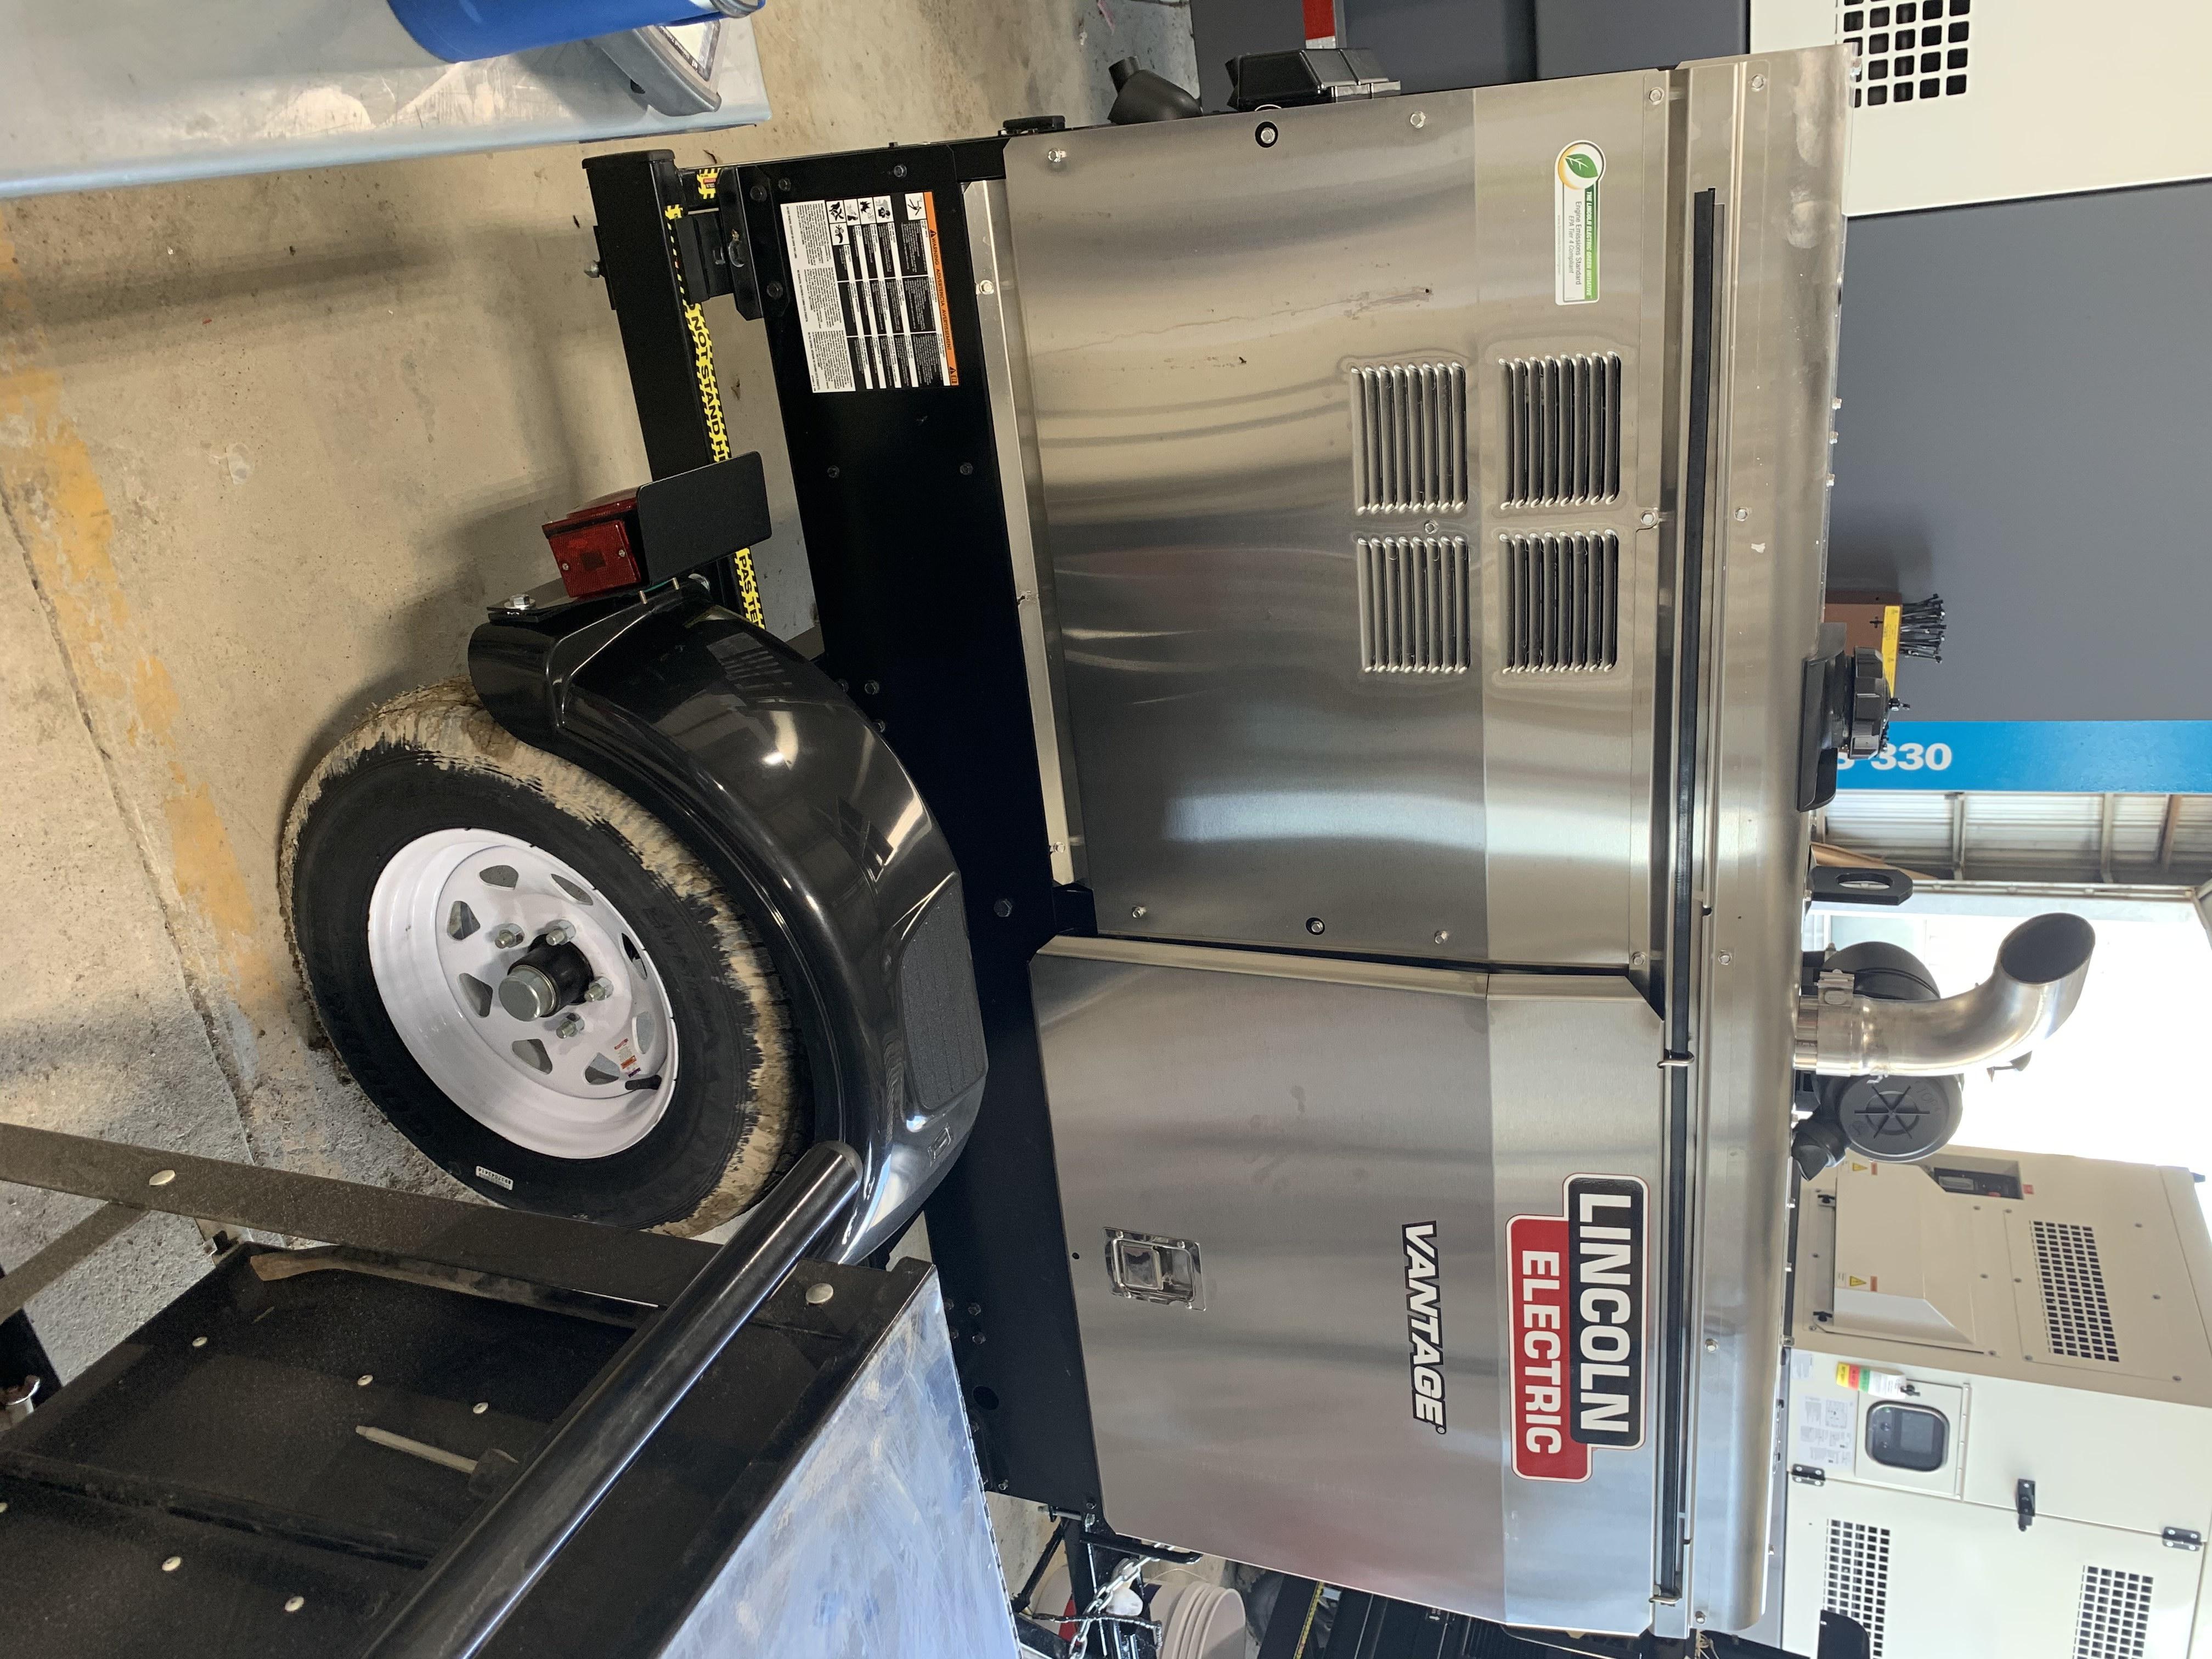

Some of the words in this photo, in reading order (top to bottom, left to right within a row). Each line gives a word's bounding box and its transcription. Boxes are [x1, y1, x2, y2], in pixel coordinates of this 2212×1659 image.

[931, 238, 939, 266] WARNING
[935, 268, 945, 307] ADVERTENCIA
[941, 309, 951, 351] AVERTISSEMENT
[691, 317, 708, 359] NOT
[701, 365, 720, 436] STAND
[739, 556, 752, 594] PAS
[748, 596, 759, 625] TE
[1871, 743, 1952, 770] 330
[1522, 1250, 1561, 1454] ELECTRIC
[1579, 1193, 1632, 1432] LINCOLN
